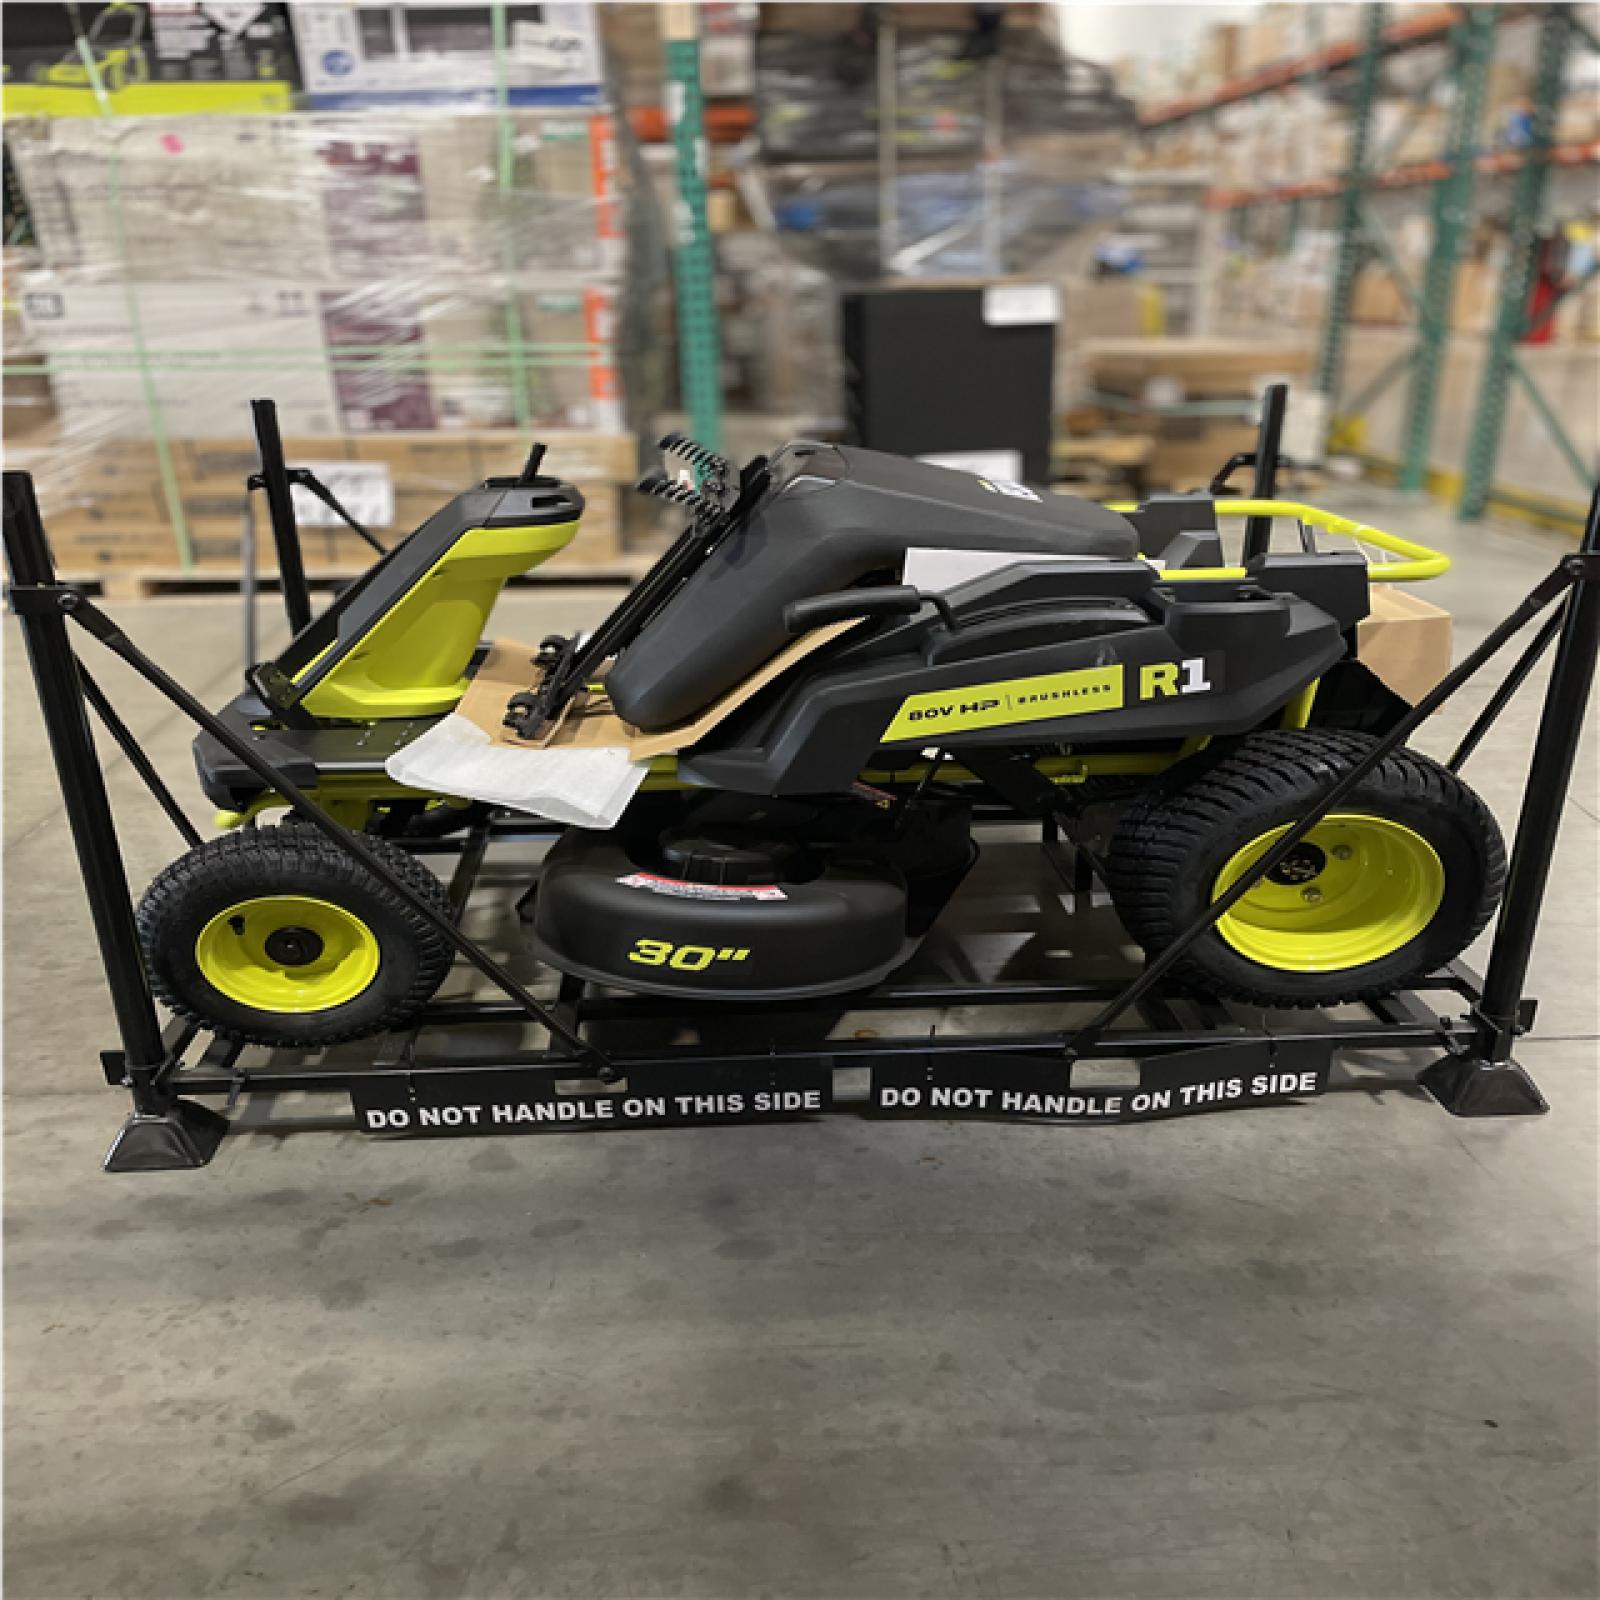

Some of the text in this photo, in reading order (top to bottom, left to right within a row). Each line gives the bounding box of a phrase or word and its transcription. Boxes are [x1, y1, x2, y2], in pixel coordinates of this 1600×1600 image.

[1139, 657, 1212, 701] R1
[908, 683, 1112, 722] 80V HP BRUSHLESS
[627, 938, 752, 971] 30"
[366, 1089, 823, 1129] DO NOT HANDLE ON THIS SIDE
[880, 1071, 1318, 1115] DO NOT HANDLE ON THIS SIDE
